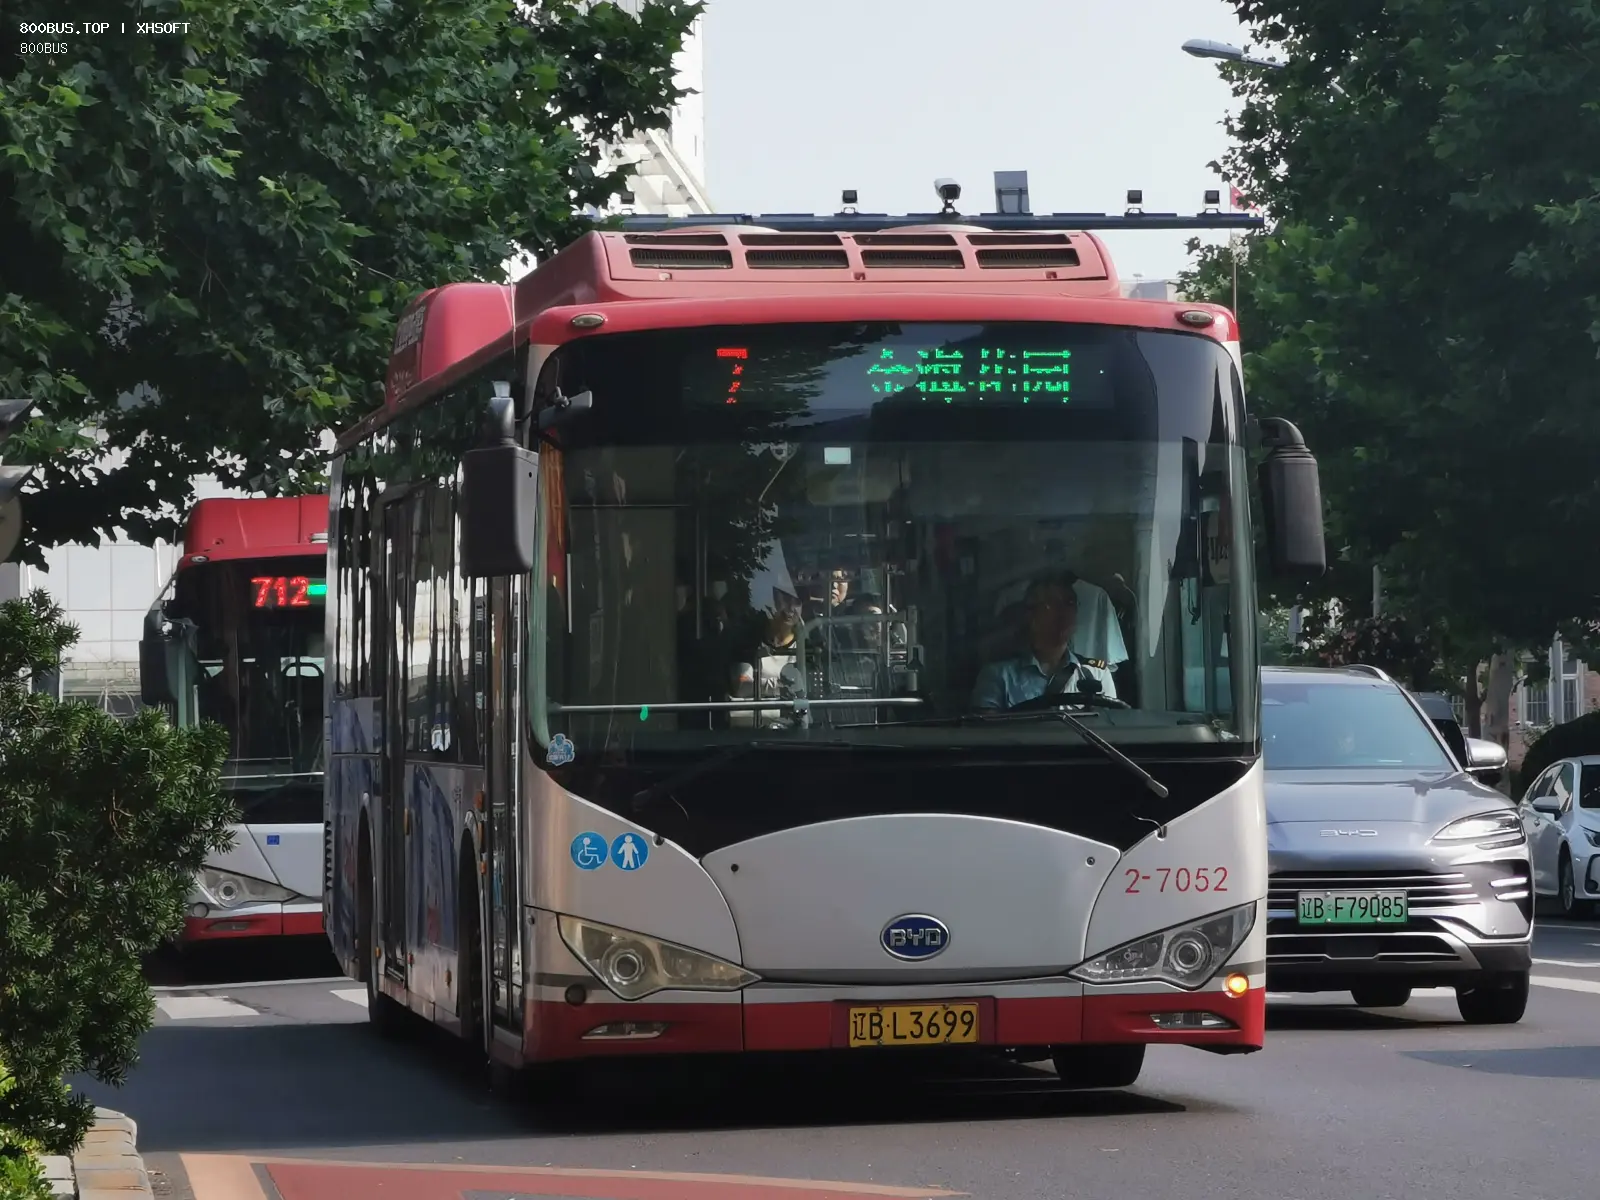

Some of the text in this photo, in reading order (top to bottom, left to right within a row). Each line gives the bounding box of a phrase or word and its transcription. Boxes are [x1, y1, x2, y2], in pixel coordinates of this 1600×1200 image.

[717, 348, 748, 404] 7
[250, 576, 310, 607] 712
[1125, 867, 1228, 893] 2-7052
[889, 928, 941, 947] BYD
